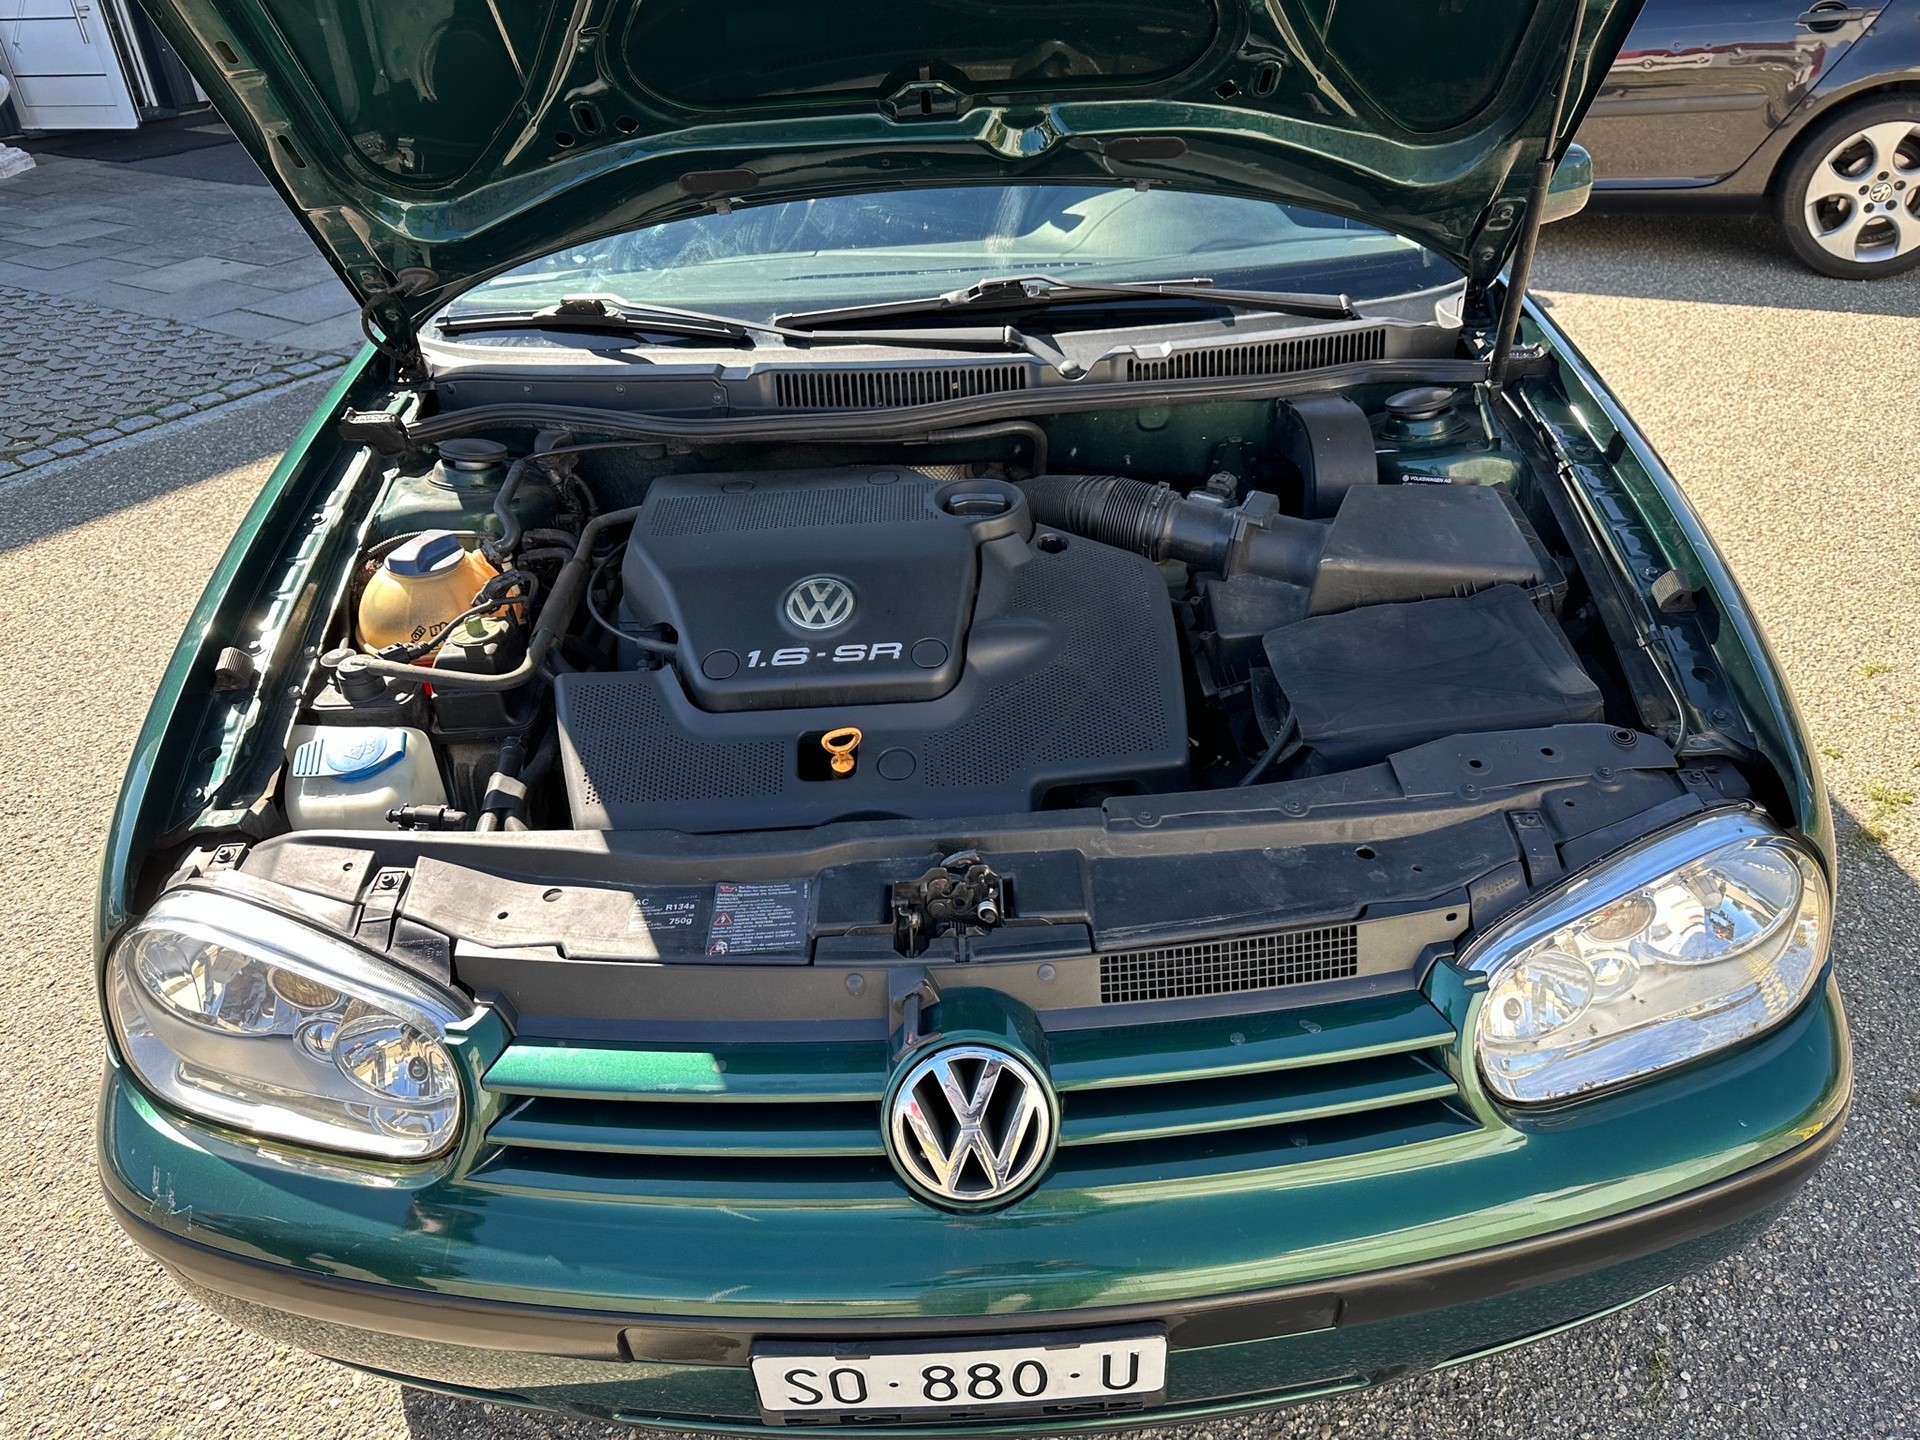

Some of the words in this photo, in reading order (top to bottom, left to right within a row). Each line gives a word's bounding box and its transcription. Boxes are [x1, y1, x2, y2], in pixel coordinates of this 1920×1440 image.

[788, 579, 853, 628] VW
[411, 626, 425, 641] G12
[634, 898, 649, 906] AC
[665, 903, 695, 911] R134a
[669, 917, 693, 925] 750g
[895, 1050, 1047, 1198] VW
[784, 1368, 868, 1405] SO
[921, 1360, 1048, 1402] 880
[1102, 1351, 1140, 1390] U
